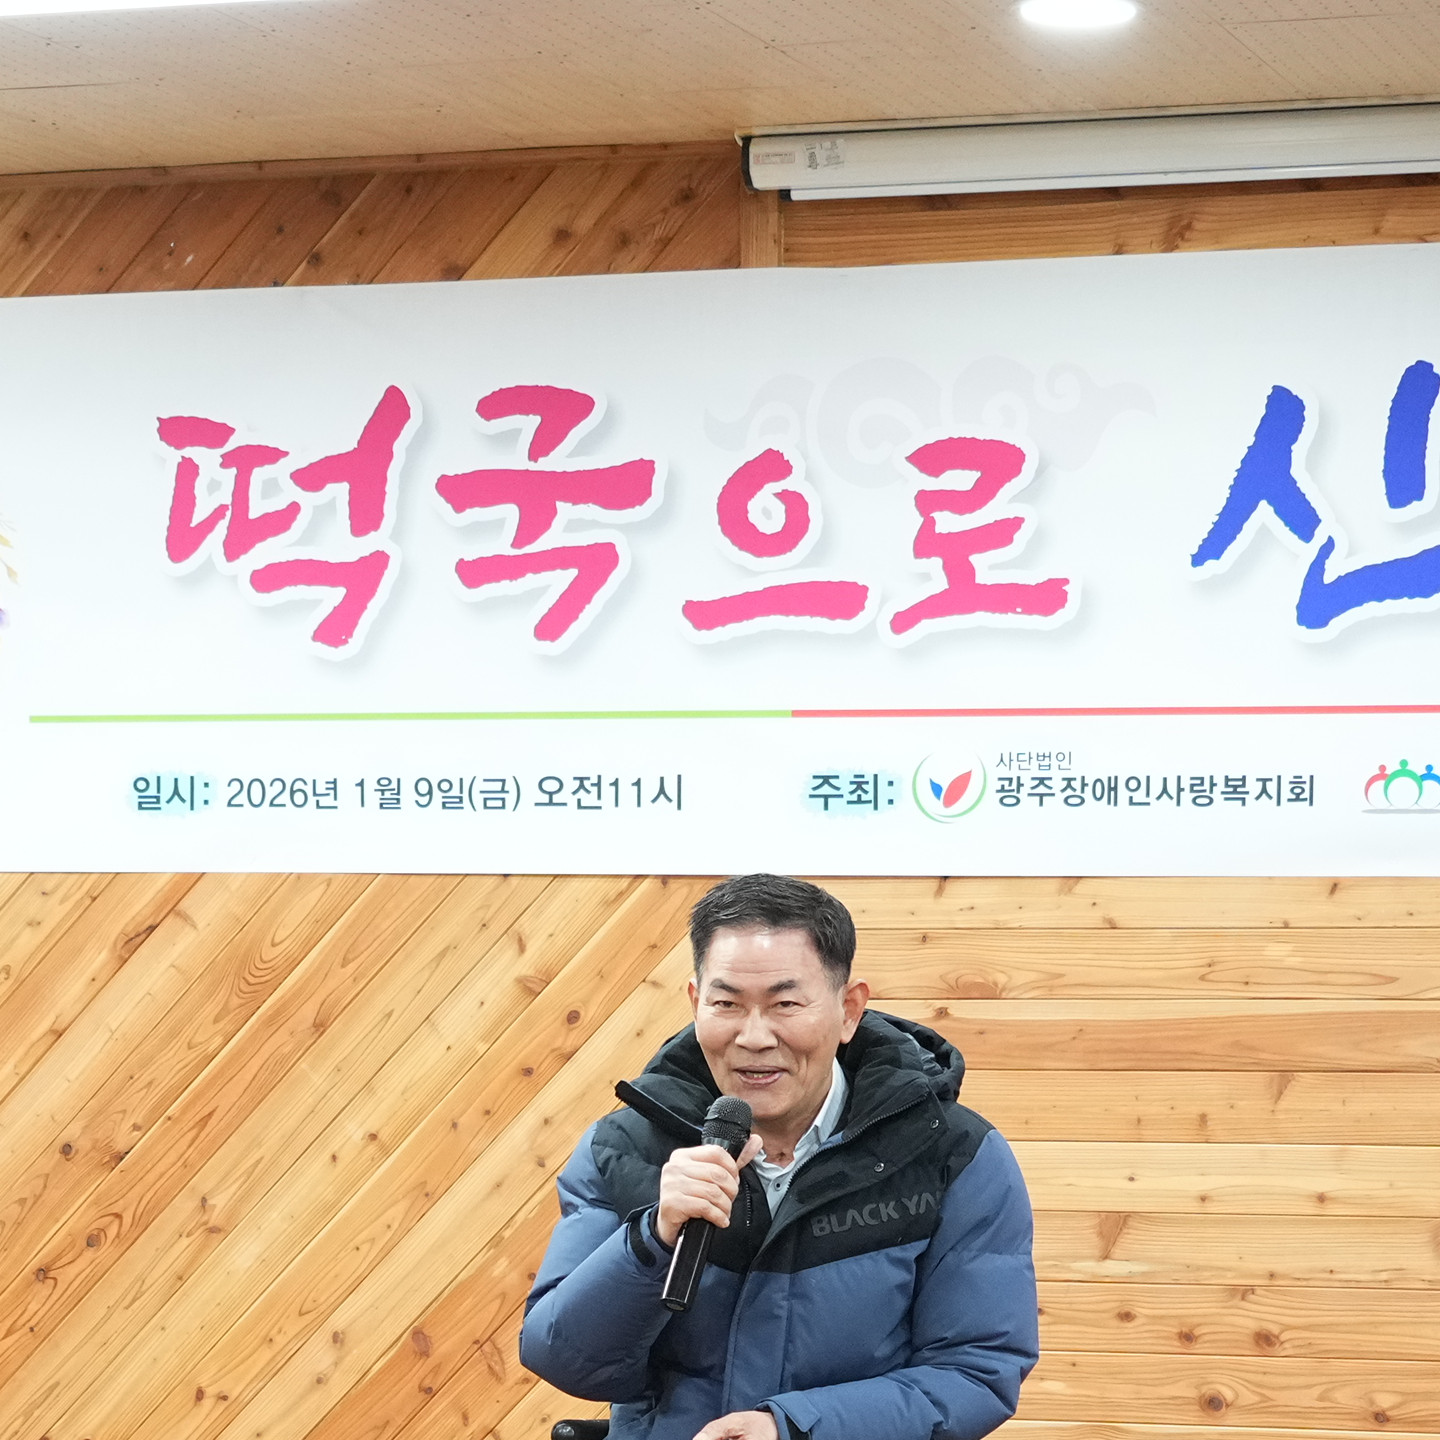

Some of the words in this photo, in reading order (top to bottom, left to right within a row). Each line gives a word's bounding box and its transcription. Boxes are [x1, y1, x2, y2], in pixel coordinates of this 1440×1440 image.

[158, 385, 1070, 647] 떡국으로
[995, 751, 1072, 772] 사단법인
[132, 774, 210, 811] 일시:
[226, 776, 339, 809] 2026년
[354, 776, 402, 808] 1월
[414, 775, 521, 811] 9일(금)
[534, 774, 682, 811] 오전11시
[808, 773, 894, 811] 주최:
[995, 774, 1314, 808] 광주장애인사랑복지회
[811, 1200, 899, 1237] BLACK
[900, 1191, 941, 1216] YA
